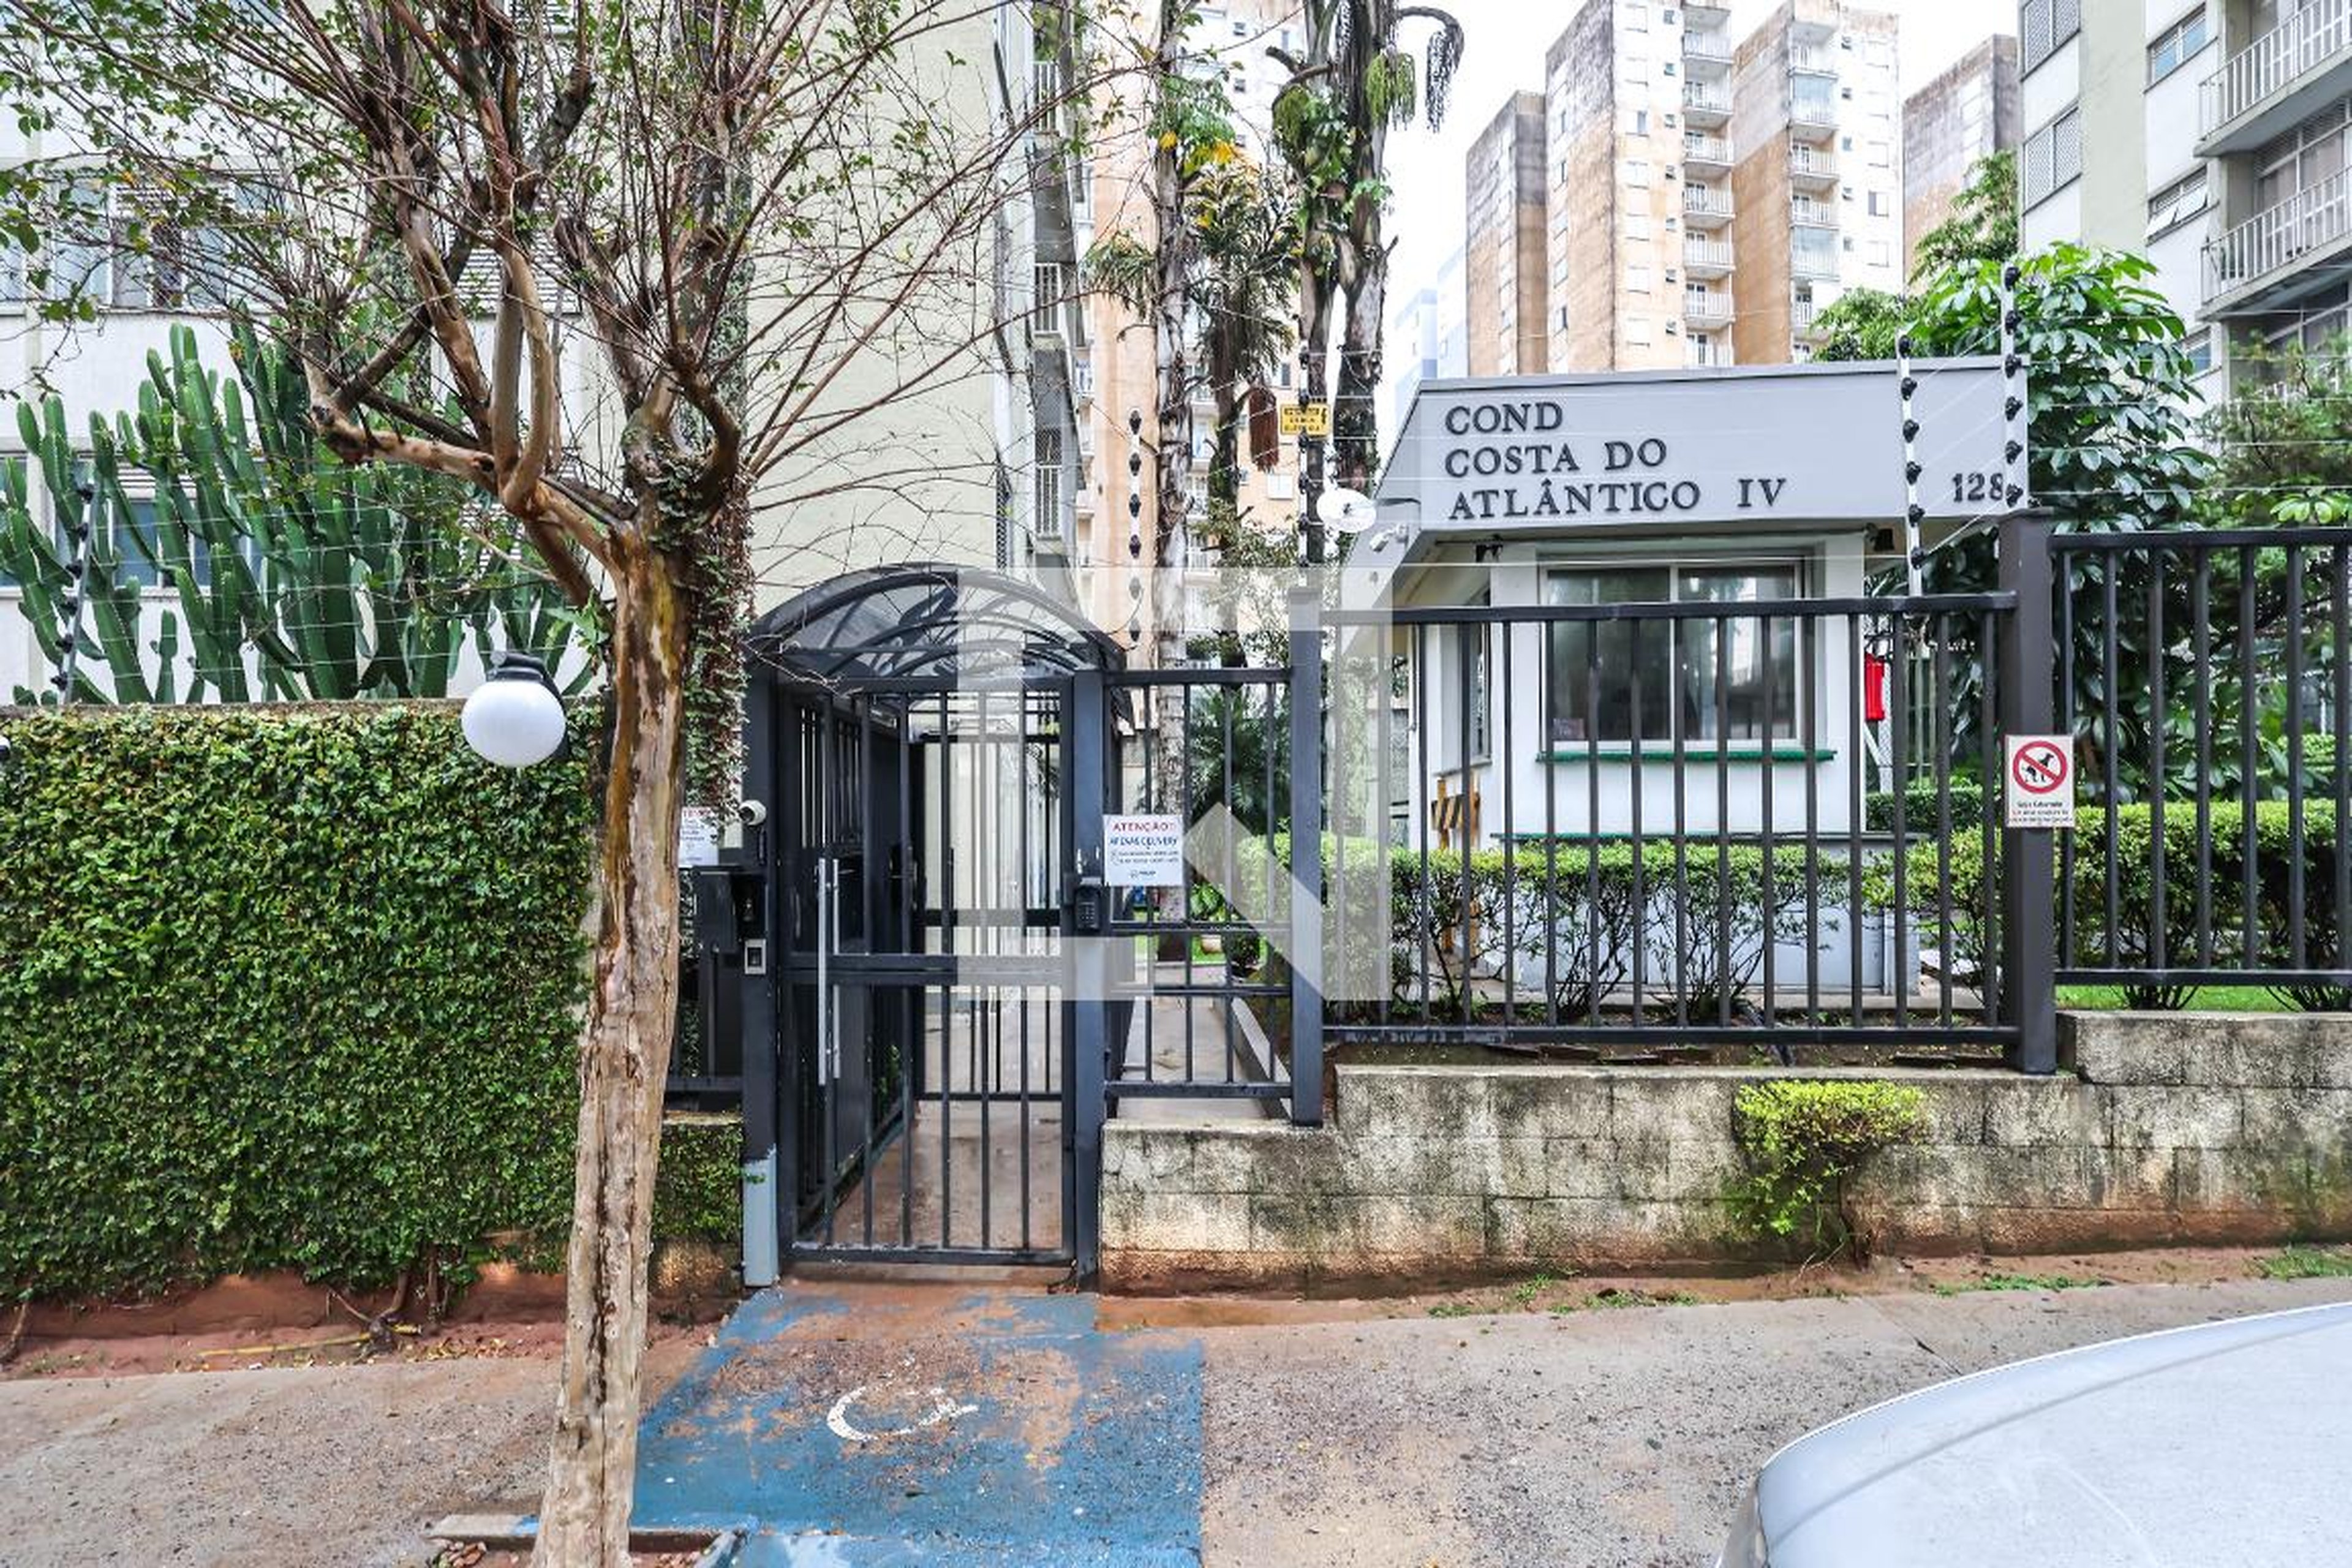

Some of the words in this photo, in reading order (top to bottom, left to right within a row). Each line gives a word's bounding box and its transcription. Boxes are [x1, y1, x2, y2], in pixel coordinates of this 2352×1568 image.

[1445, 402, 1562, 435] COND
[1445, 443, 1580, 478] COSTA
[1604, 438, 1667, 470] DO
[1448, 478, 1701, 521] ATLÂNTICO
[1737, 478, 1787, 508] IV
[1953, 472, 2003, 502] 128
